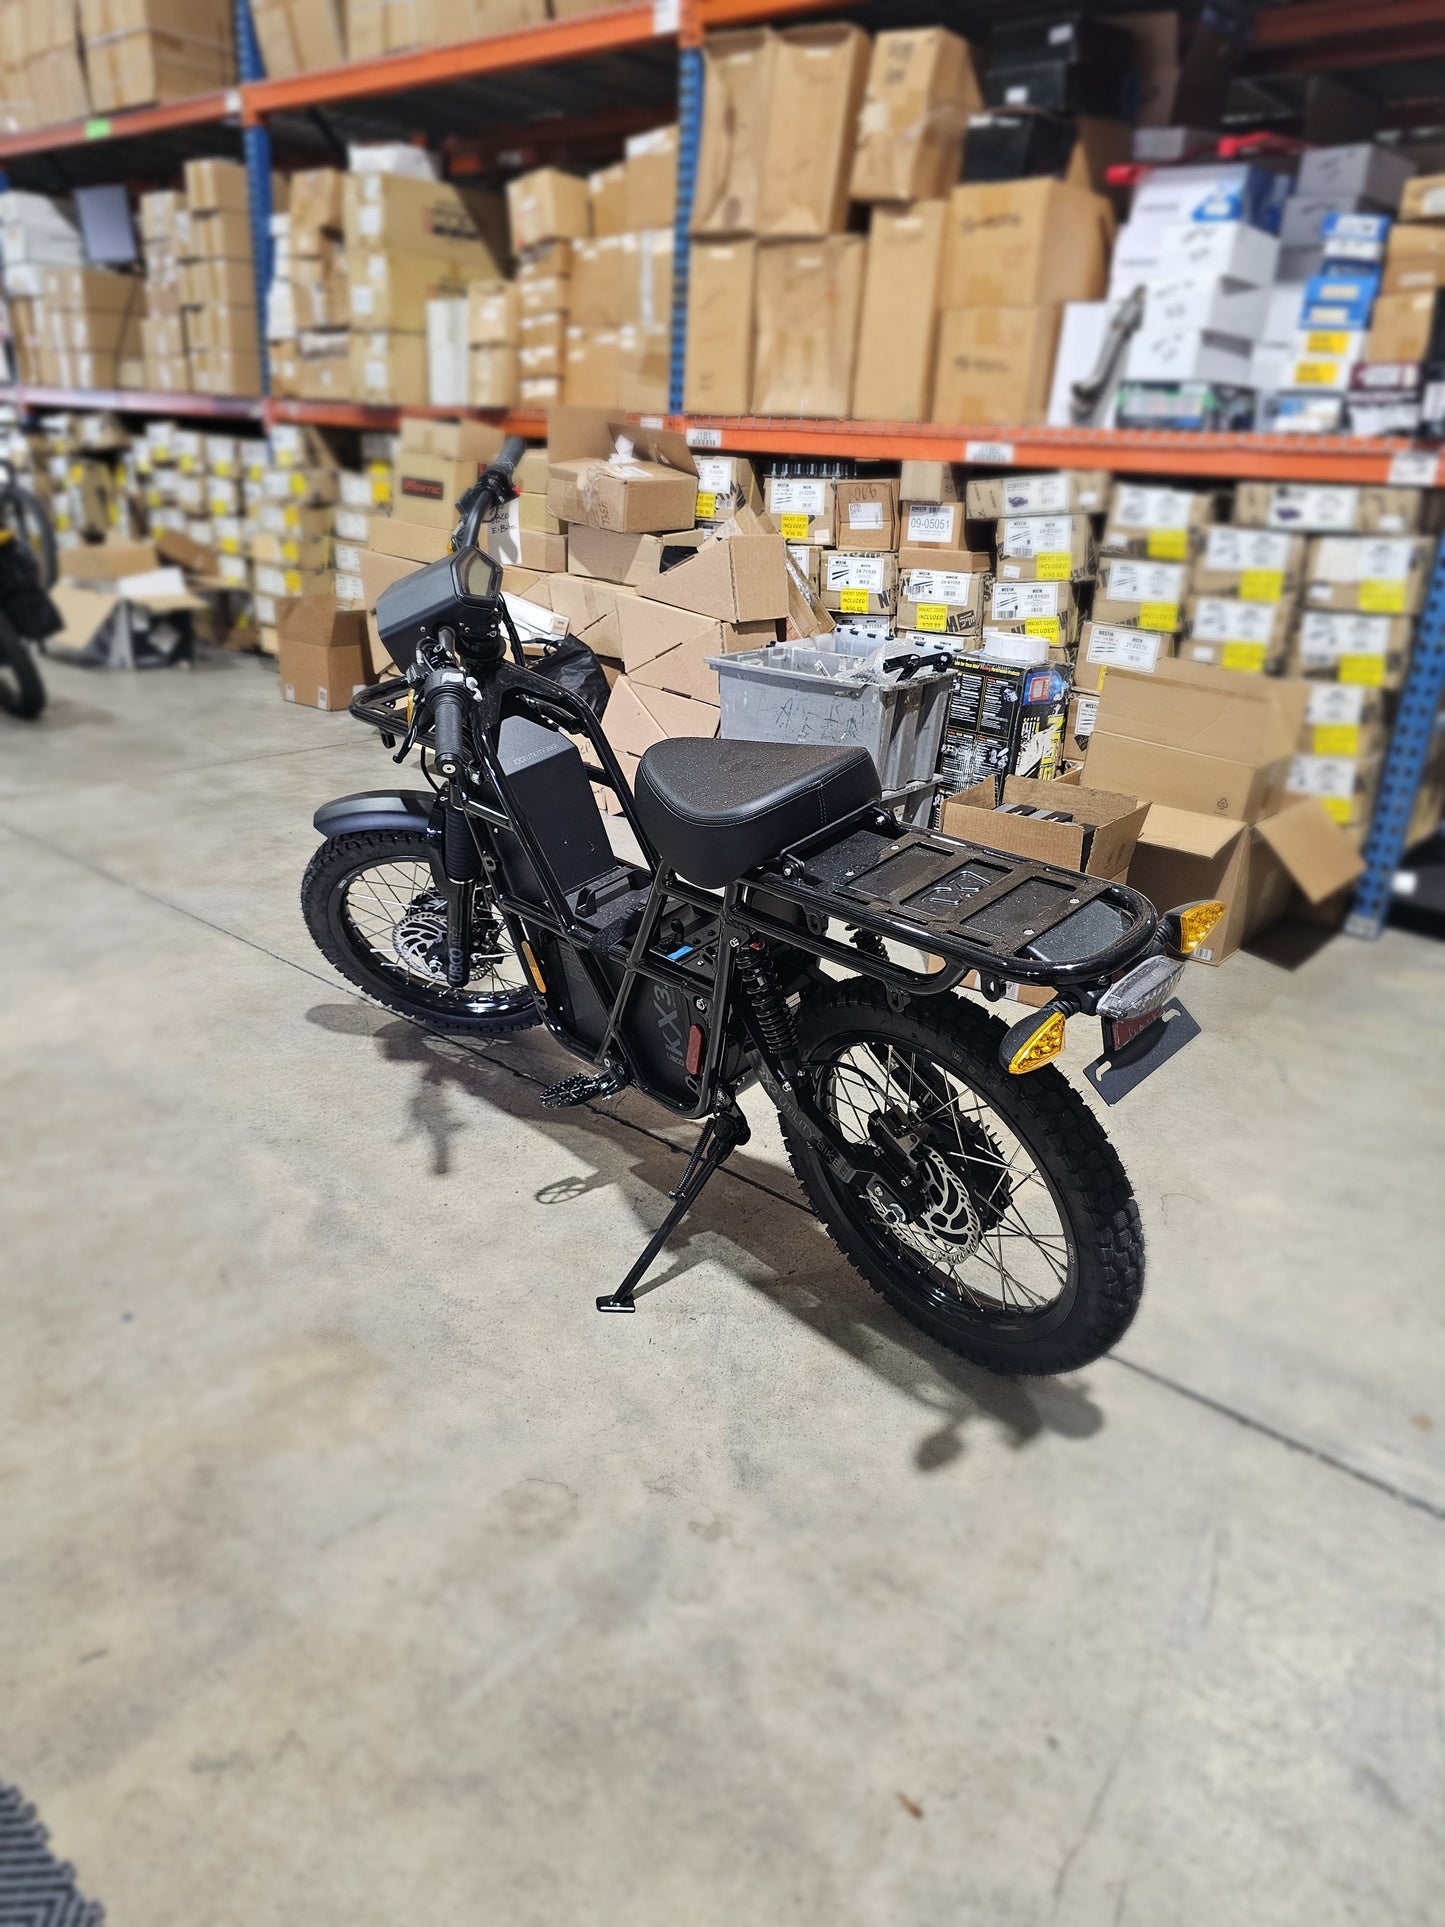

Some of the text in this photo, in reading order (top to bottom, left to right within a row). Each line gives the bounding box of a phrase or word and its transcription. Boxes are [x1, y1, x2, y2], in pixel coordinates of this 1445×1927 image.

[910, 518, 950, 529] 09-05051
[449, 948, 463, 981] UBCO
[779, 1094, 815, 1138] UTILITY
[816, 1140, 840, 1168] BIKE
